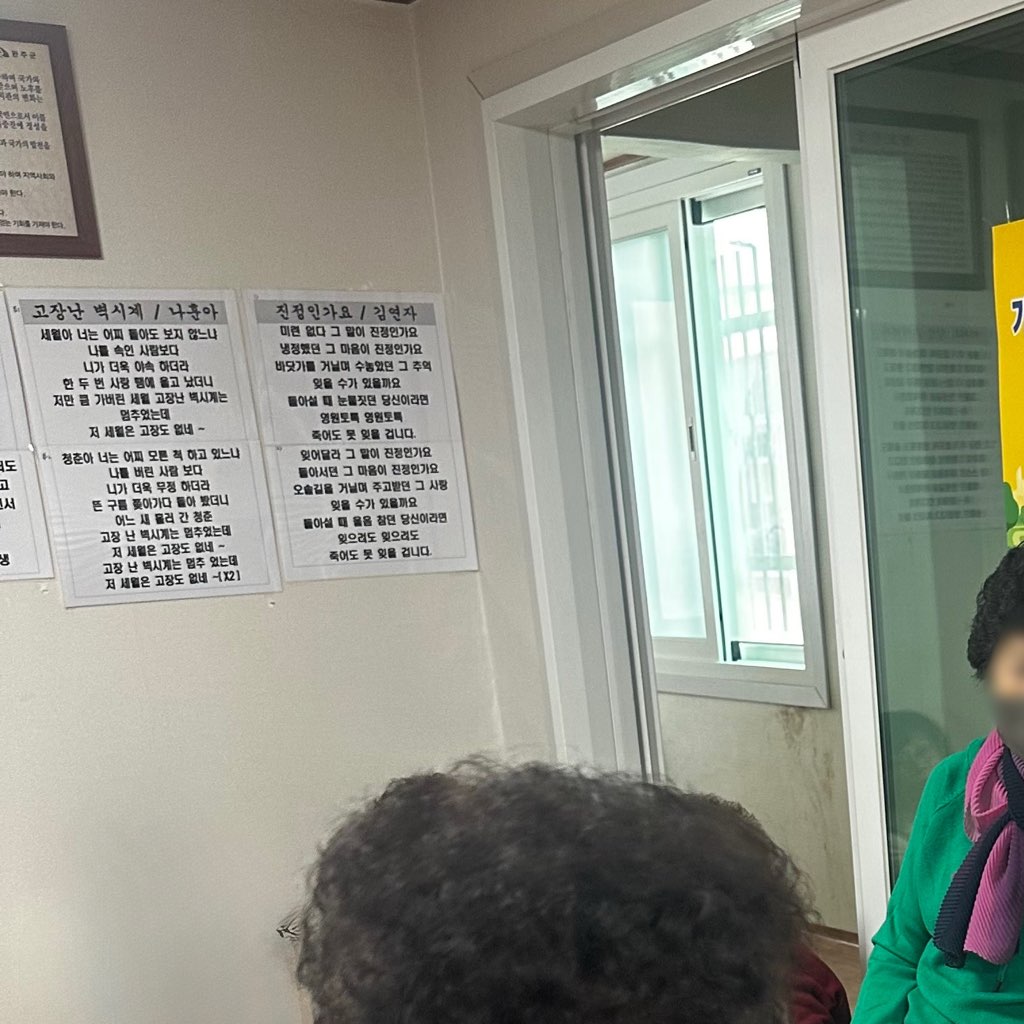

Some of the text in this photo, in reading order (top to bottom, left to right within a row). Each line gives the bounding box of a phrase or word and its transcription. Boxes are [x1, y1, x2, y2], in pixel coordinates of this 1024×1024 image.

[32, 302, 85, 321] 고장난
[93, 302, 143, 321] 벽시계
[168, 303, 219, 321] 나훈아
[276, 303, 353, 321] 진정인가요
[373, 304, 417, 322] 김연자
